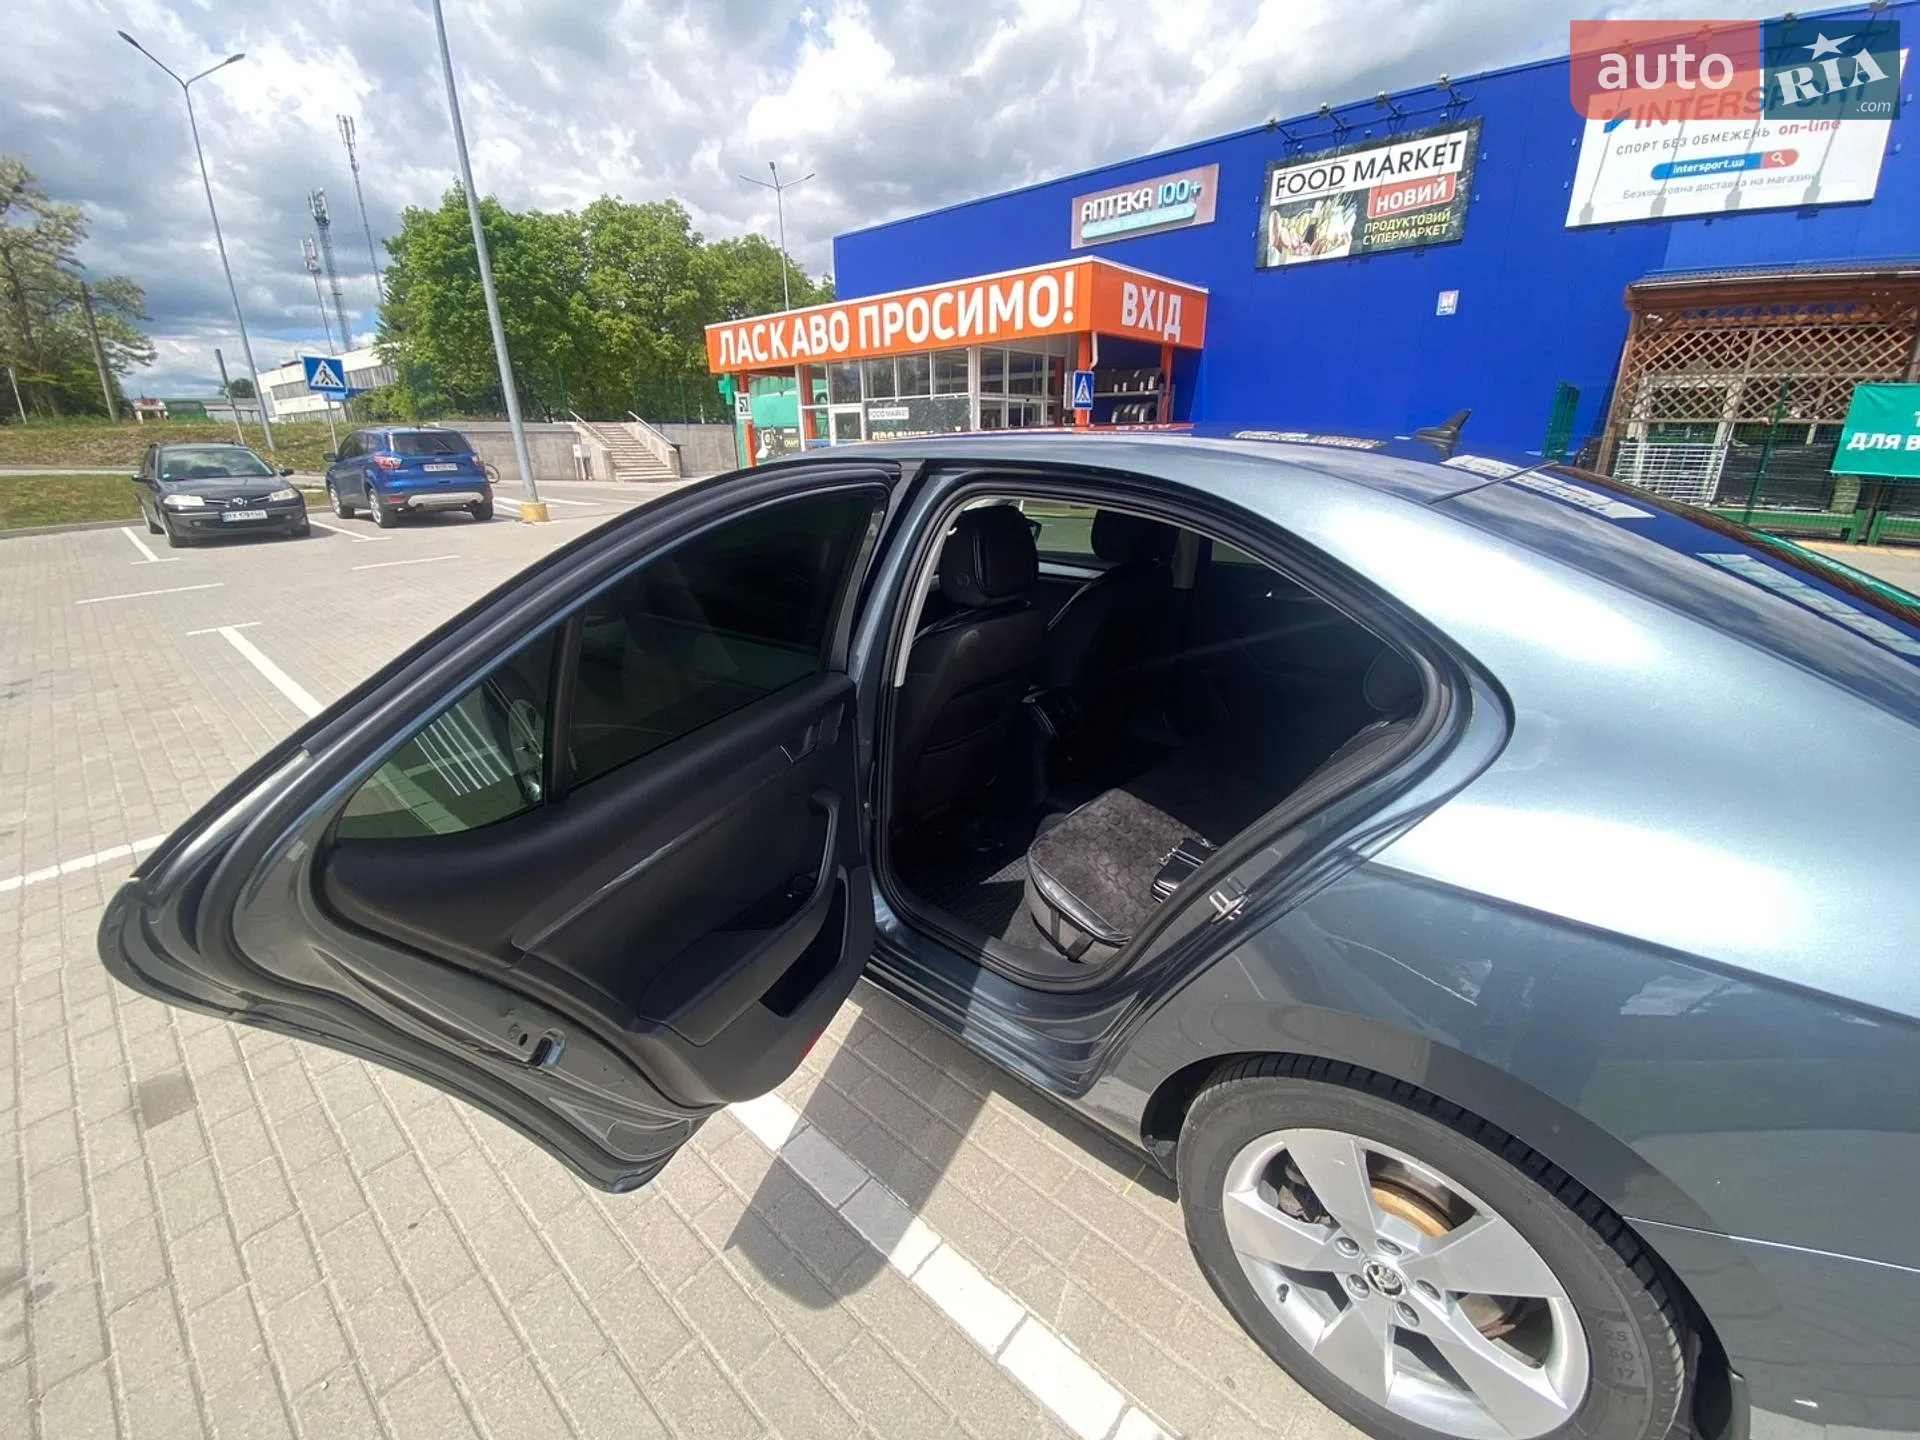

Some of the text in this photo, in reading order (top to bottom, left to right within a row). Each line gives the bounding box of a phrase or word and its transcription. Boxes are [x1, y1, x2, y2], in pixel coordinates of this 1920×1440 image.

[1616, 119, 1842, 157] СПОРТ БЕЗ ОБМЕЖЕНЬ on-line
[1275, 140, 1462, 198] FOOD MARKET
[1672, 159, 1746, 175] intersport.ua
[1081, 188, 1154, 222] АПТЕКА
[1158, 179, 1202, 205] 100+
[1376, 178, 1448, 213] НОВИЙ
[1362, 223, 1449, 246] СУПЕРМАРКЕТ
[1363, 206, 1452, 233] ПРОДУКТОВИЙ
[718, 270, 1075, 367] ЛАСКАВО ПРОСИМО!
[1121, 281, 1183, 343] ВХІД
[1846, 432, 1902, 451] ДЛЯ
